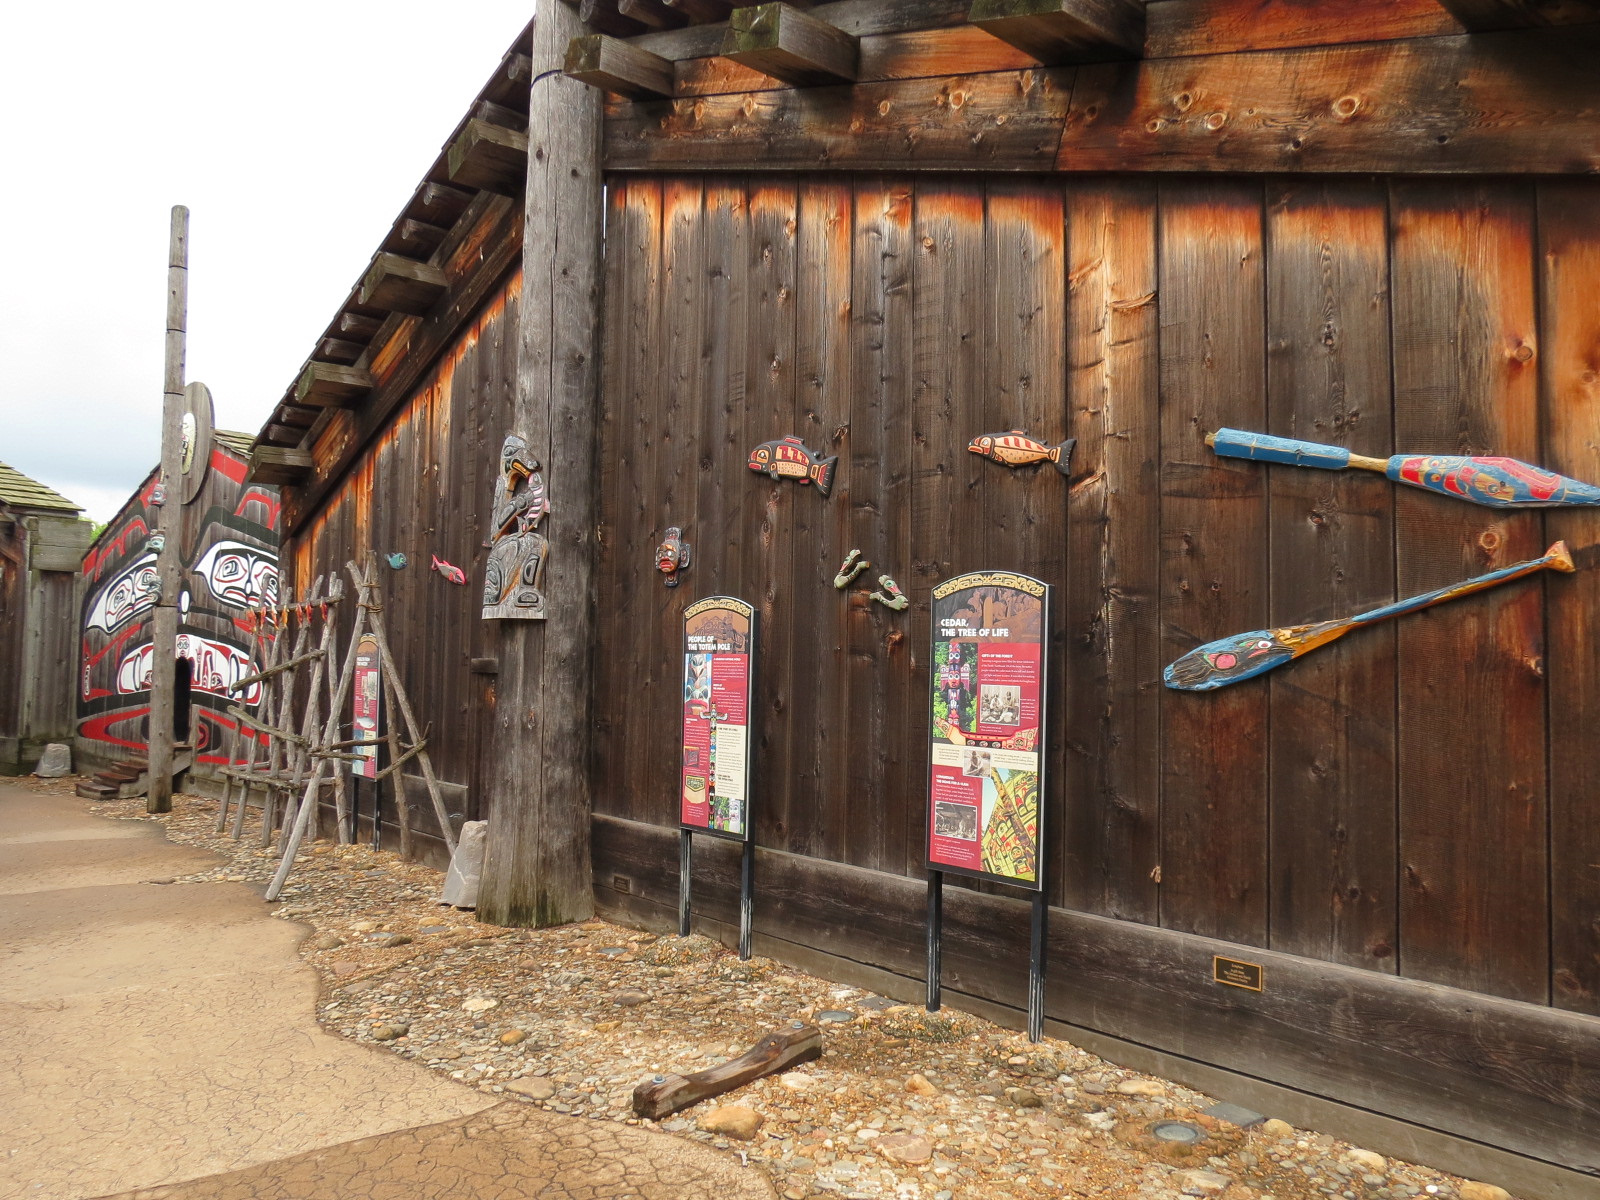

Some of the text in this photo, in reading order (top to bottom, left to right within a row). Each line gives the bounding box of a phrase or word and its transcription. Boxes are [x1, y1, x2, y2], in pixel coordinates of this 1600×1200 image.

[941, 618, 969, 627] CEDAR,
[941, 628, 1008, 637] THE TREE OF LIFE
